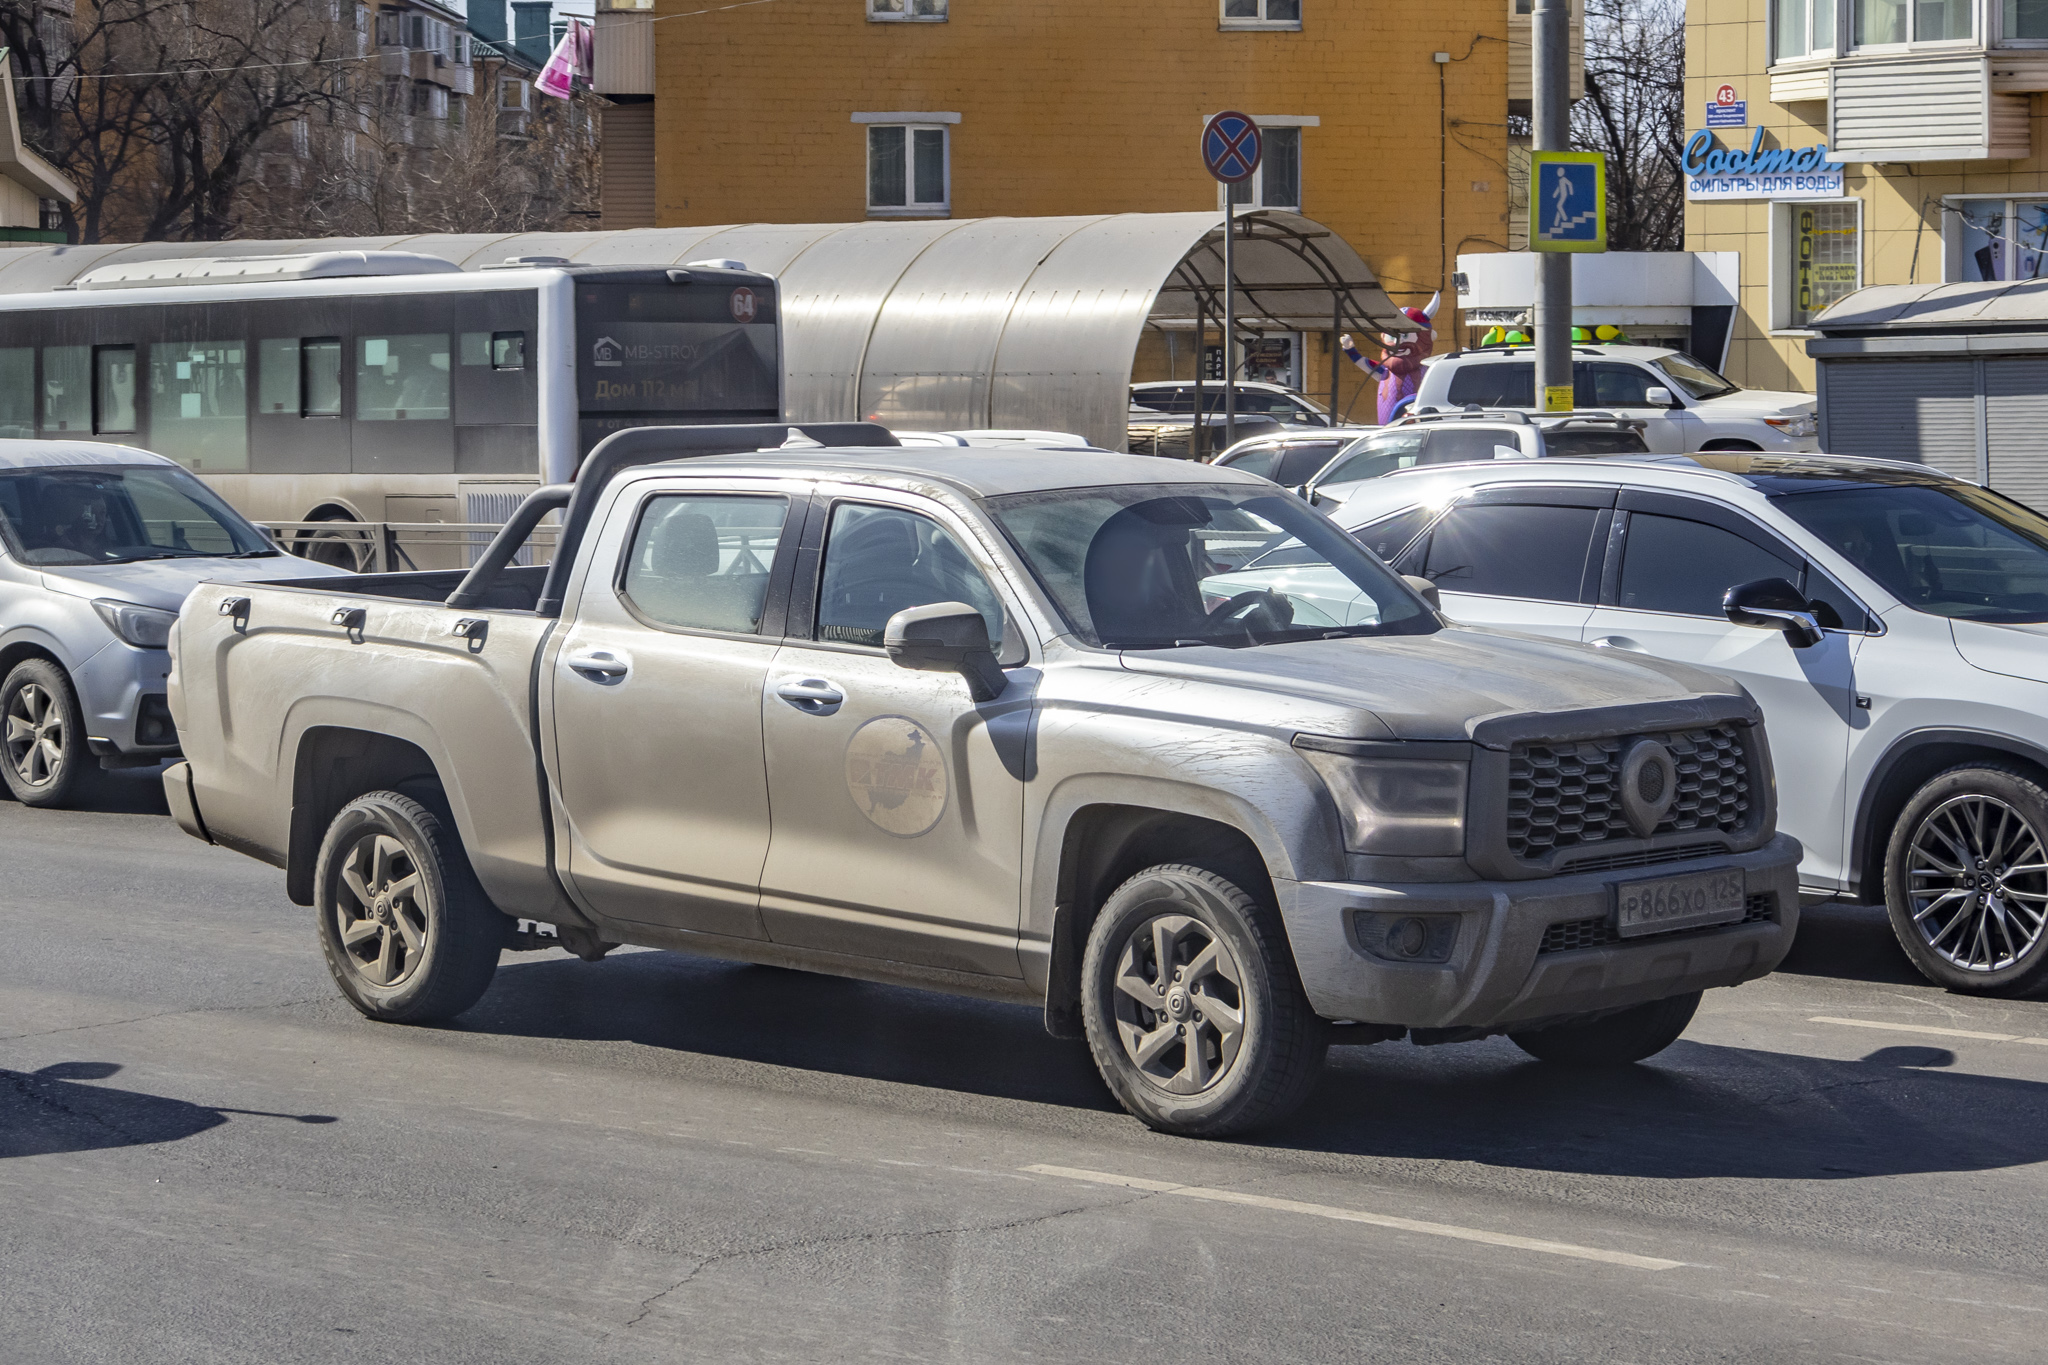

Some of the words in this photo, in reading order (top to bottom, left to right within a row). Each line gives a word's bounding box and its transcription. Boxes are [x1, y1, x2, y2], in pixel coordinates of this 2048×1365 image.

[1718, 89, 1734, 103] 43
[1689, 177, 1759, 192] ФИЛЬТРЫ
[1762, 176, 1792, 193] ДЛЯ
[1796, 176, 1840, 192] ВОДЫ
[1799, 211, 1813, 311] ФОТО
[733, 294, 754, 316] 64
[625, 345, 699, 359] MB-STROY
[595, 380, 635, 400] Дом
[641, 380, 665, 397] 112
[1709, 873, 1742, 900] 125
